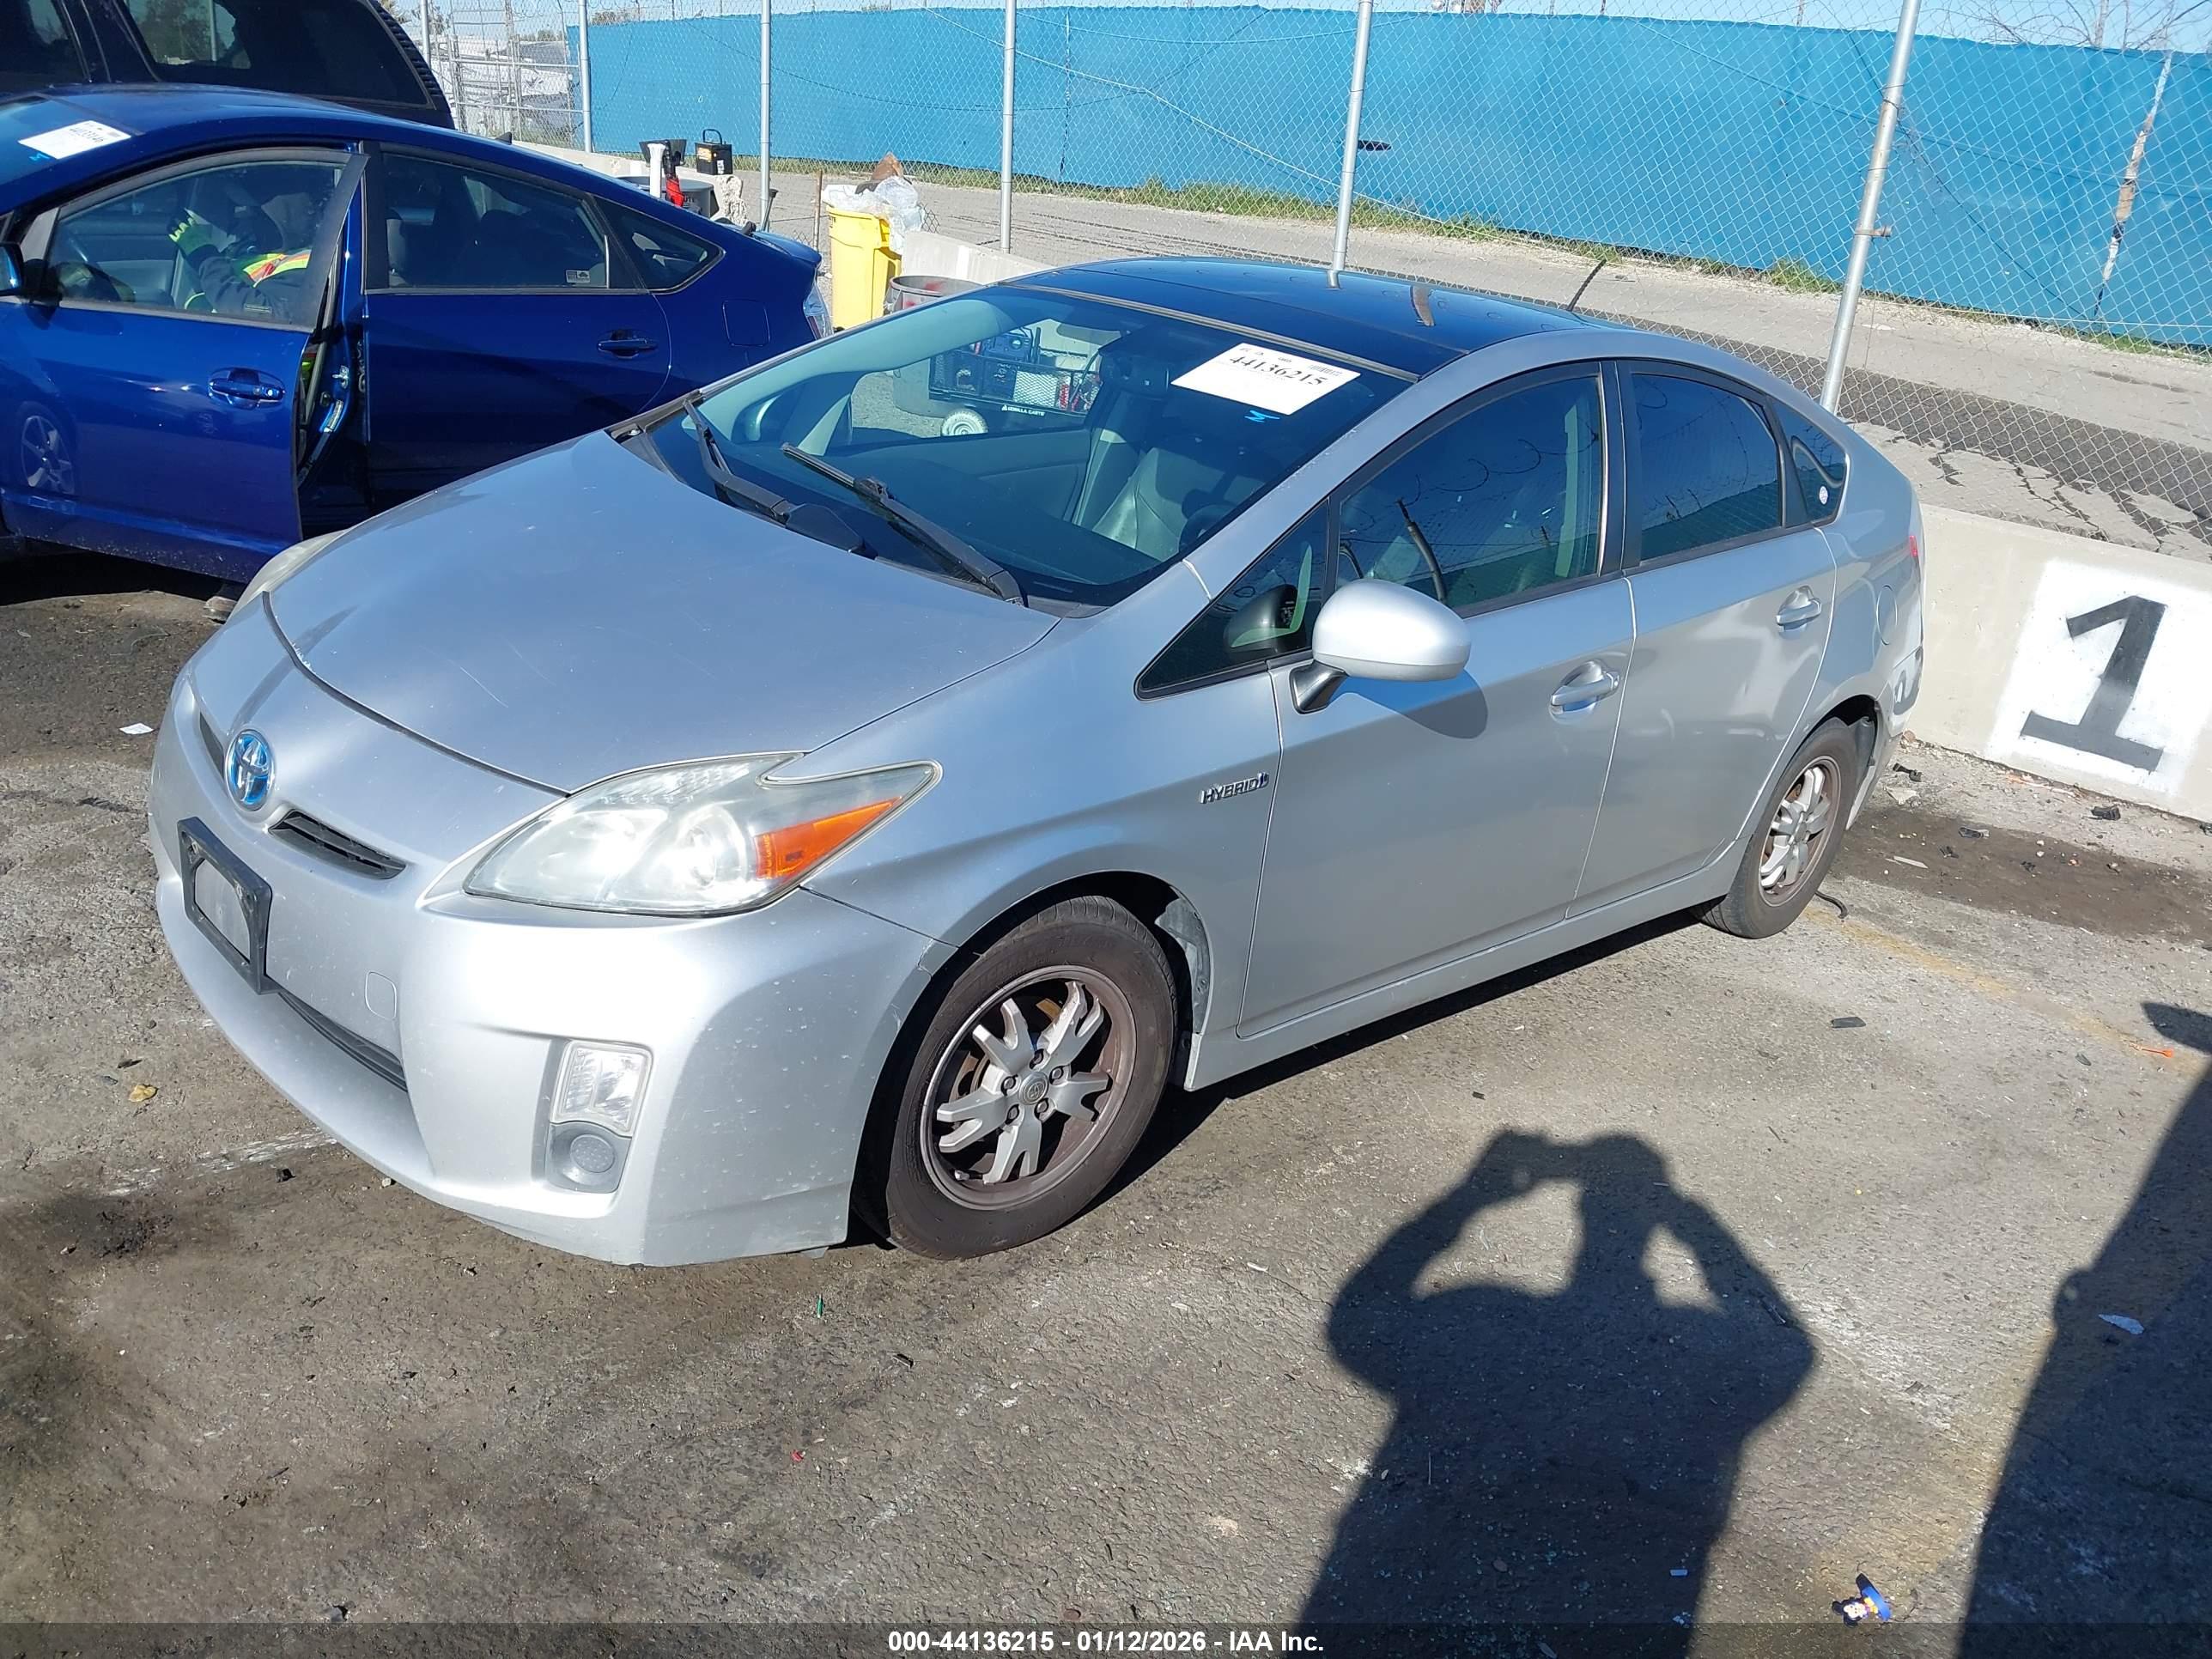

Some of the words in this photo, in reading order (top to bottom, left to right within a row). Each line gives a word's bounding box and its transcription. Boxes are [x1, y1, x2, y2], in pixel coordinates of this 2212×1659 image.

[1229, 356, 1328, 386] 44136215
[2019, 594, 2169, 775] 1
[1199, 776, 1260, 804] HYBRID
